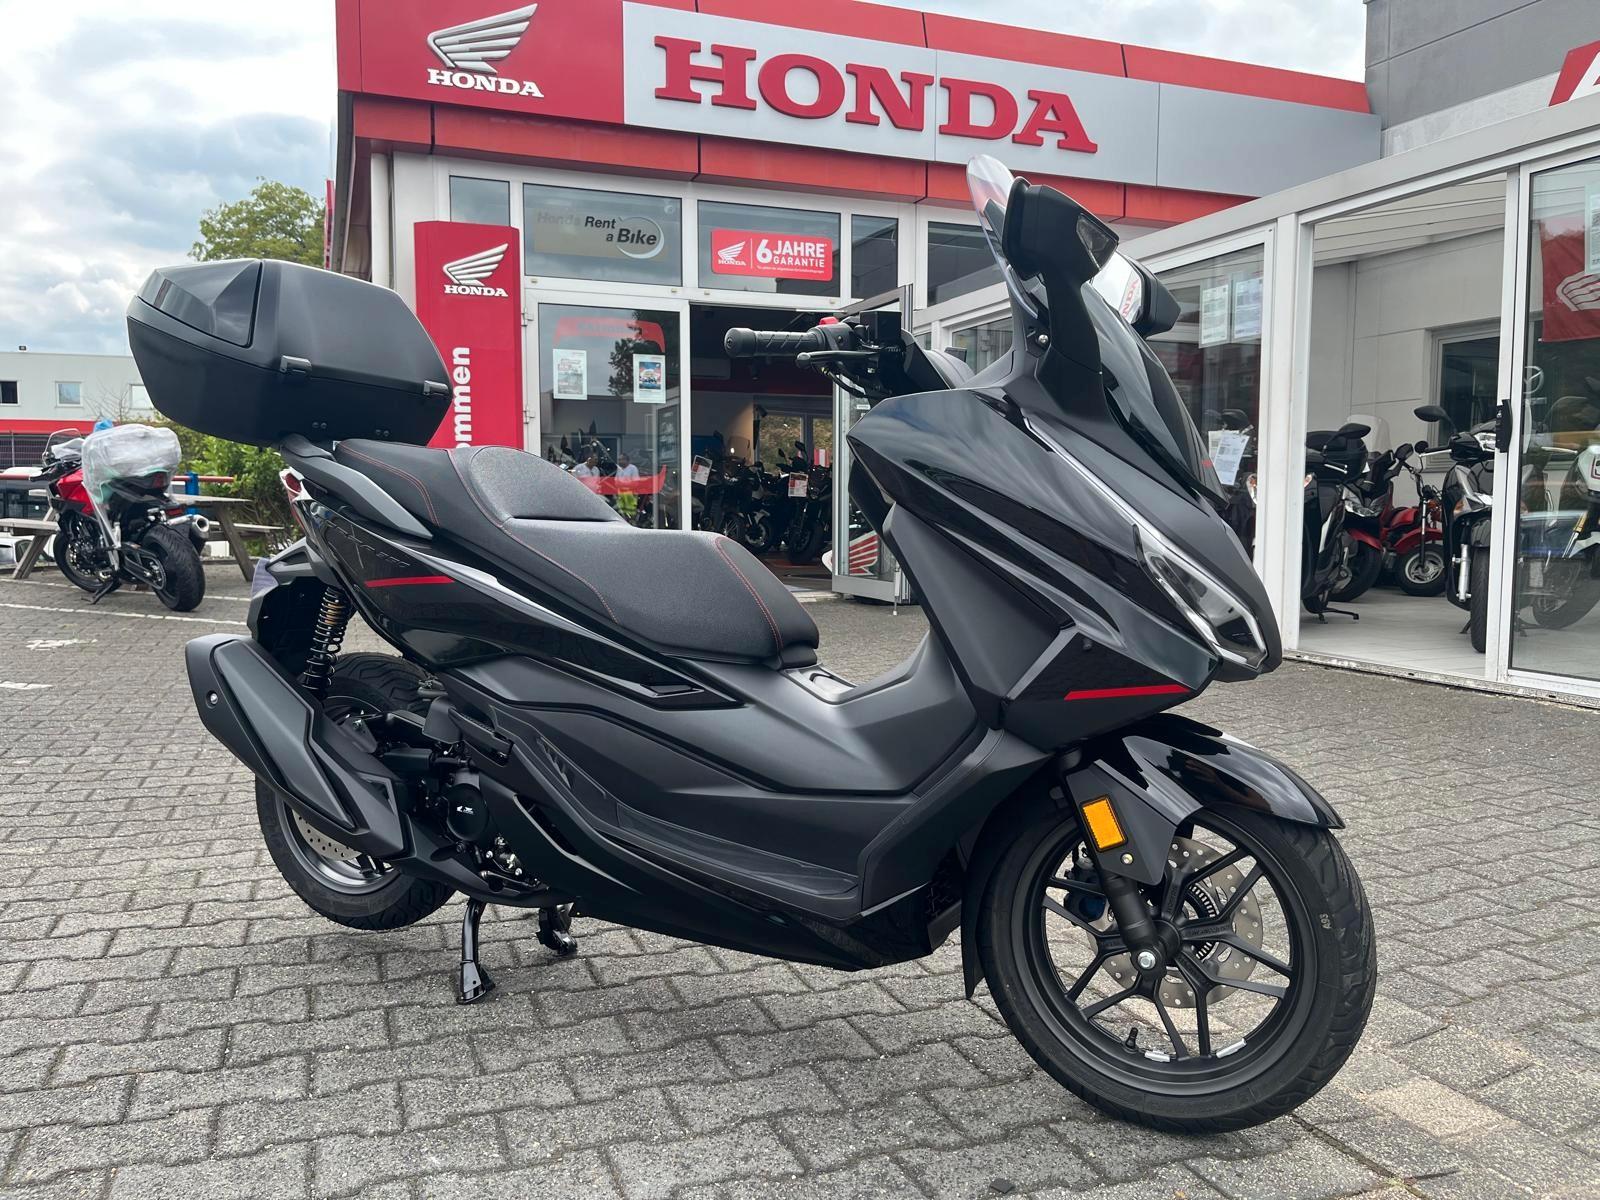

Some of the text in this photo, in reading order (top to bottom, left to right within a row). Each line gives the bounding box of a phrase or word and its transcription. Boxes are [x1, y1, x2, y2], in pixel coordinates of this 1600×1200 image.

[427, 68, 545, 98] HONDA
[654, 35, 1098, 153] HONDA
[584, 215, 616, 229] Rent
[606, 228, 657, 245] a Bike
[756, 239, 773, 263] 6
[773, 256, 825, 268] GARANTIE
[443, 284, 509, 298] HONDA
